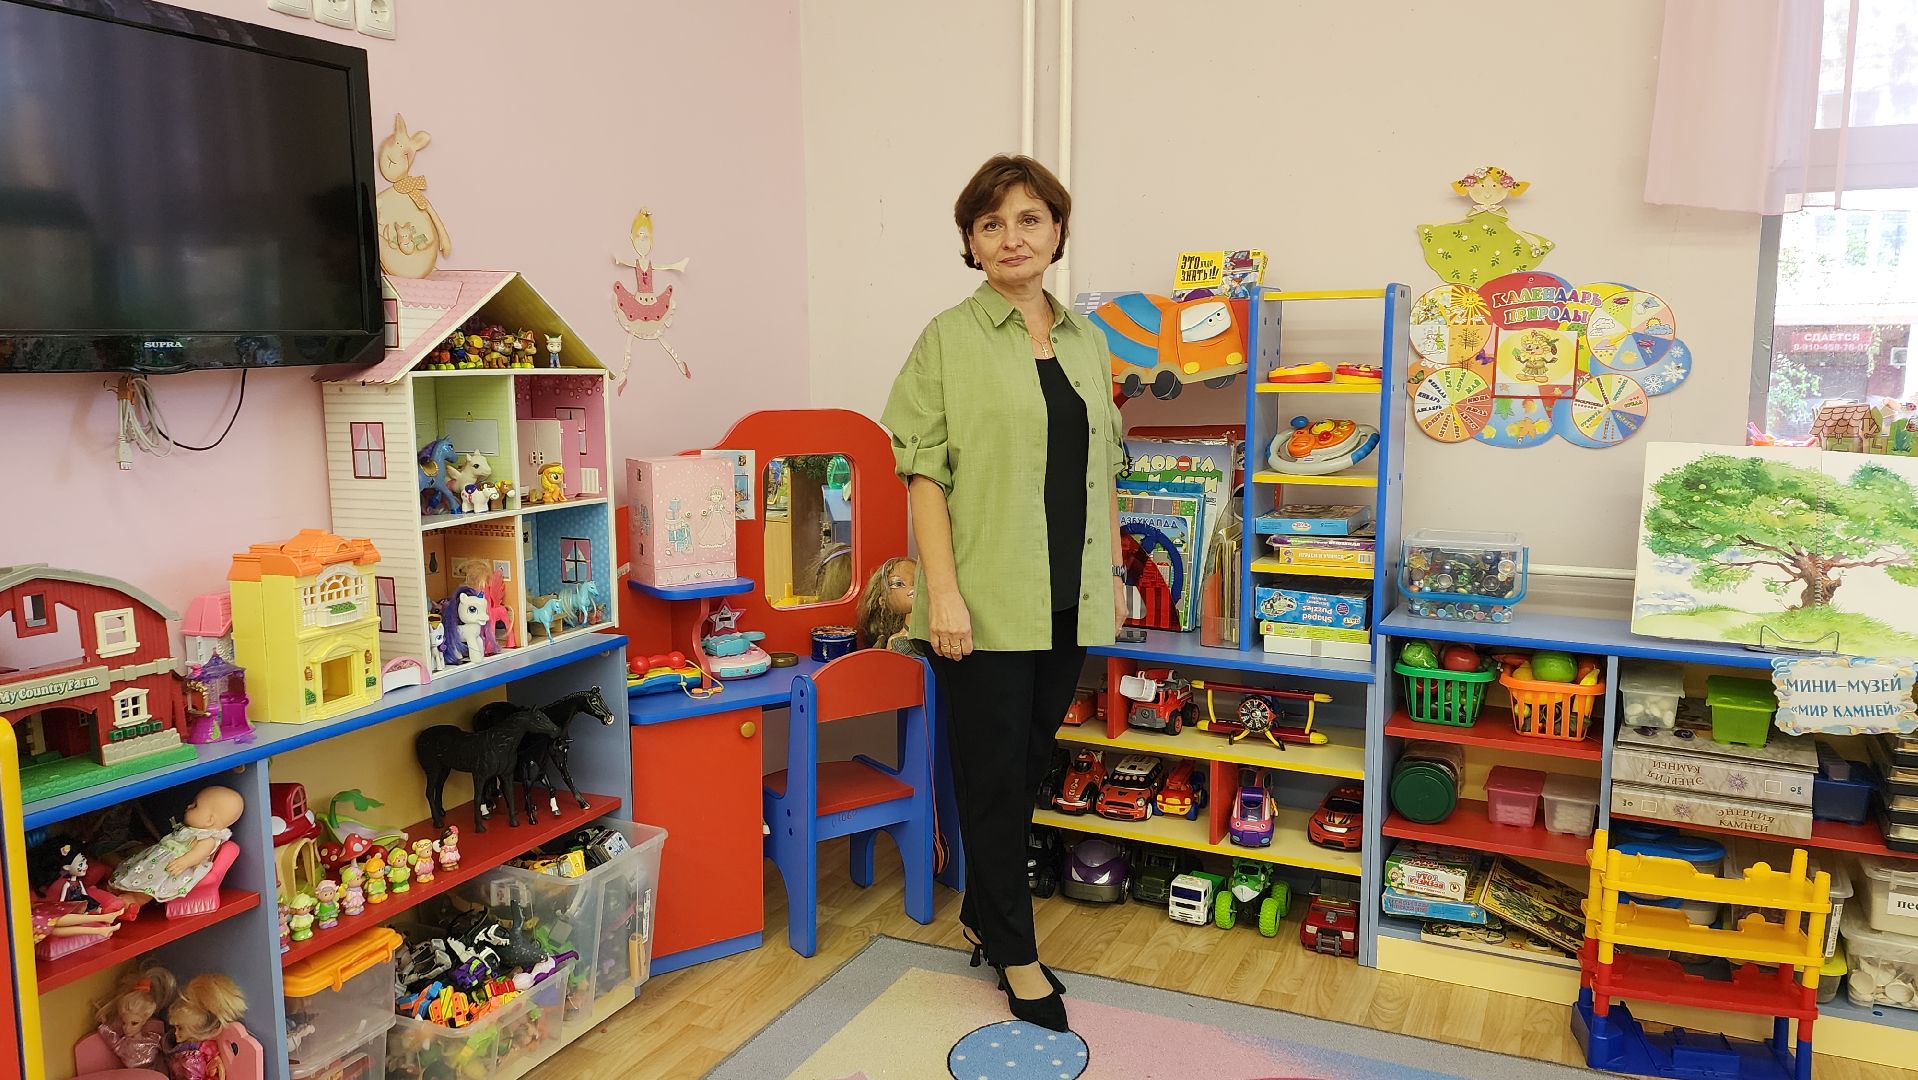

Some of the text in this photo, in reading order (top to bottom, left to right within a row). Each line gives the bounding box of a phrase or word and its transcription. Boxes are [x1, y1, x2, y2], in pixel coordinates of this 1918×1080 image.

[1181, 255, 1201, 269] ЭТО
[1493, 287, 1602, 307] КАЛЕНДАРЬ
[1505, 307, 1589, 323] ПРИРОДЫ
[1134, 454, 1216, 473] ДОРОГА
[1302, 605, 1333, 615] Puzzles
[1302, 613, 1332, 623] Shaped
[18, 682, 66, 700] Country
[68, 676, 99, 691] Farm
[1791, 701, 1900, 717] «МИР КАМНЕЙ»
[1653, 760, 1700, 774] КАМНЕЙ
[1647, 771, 1704, 786] ЭНЕРГИЯ
[1717, 808, 1775, 823] ЭНЕРГИЯ
[1719, 819, 1769, 832] КАМНЕЙ
[1416, 871, 1439, 881] ГОДА
